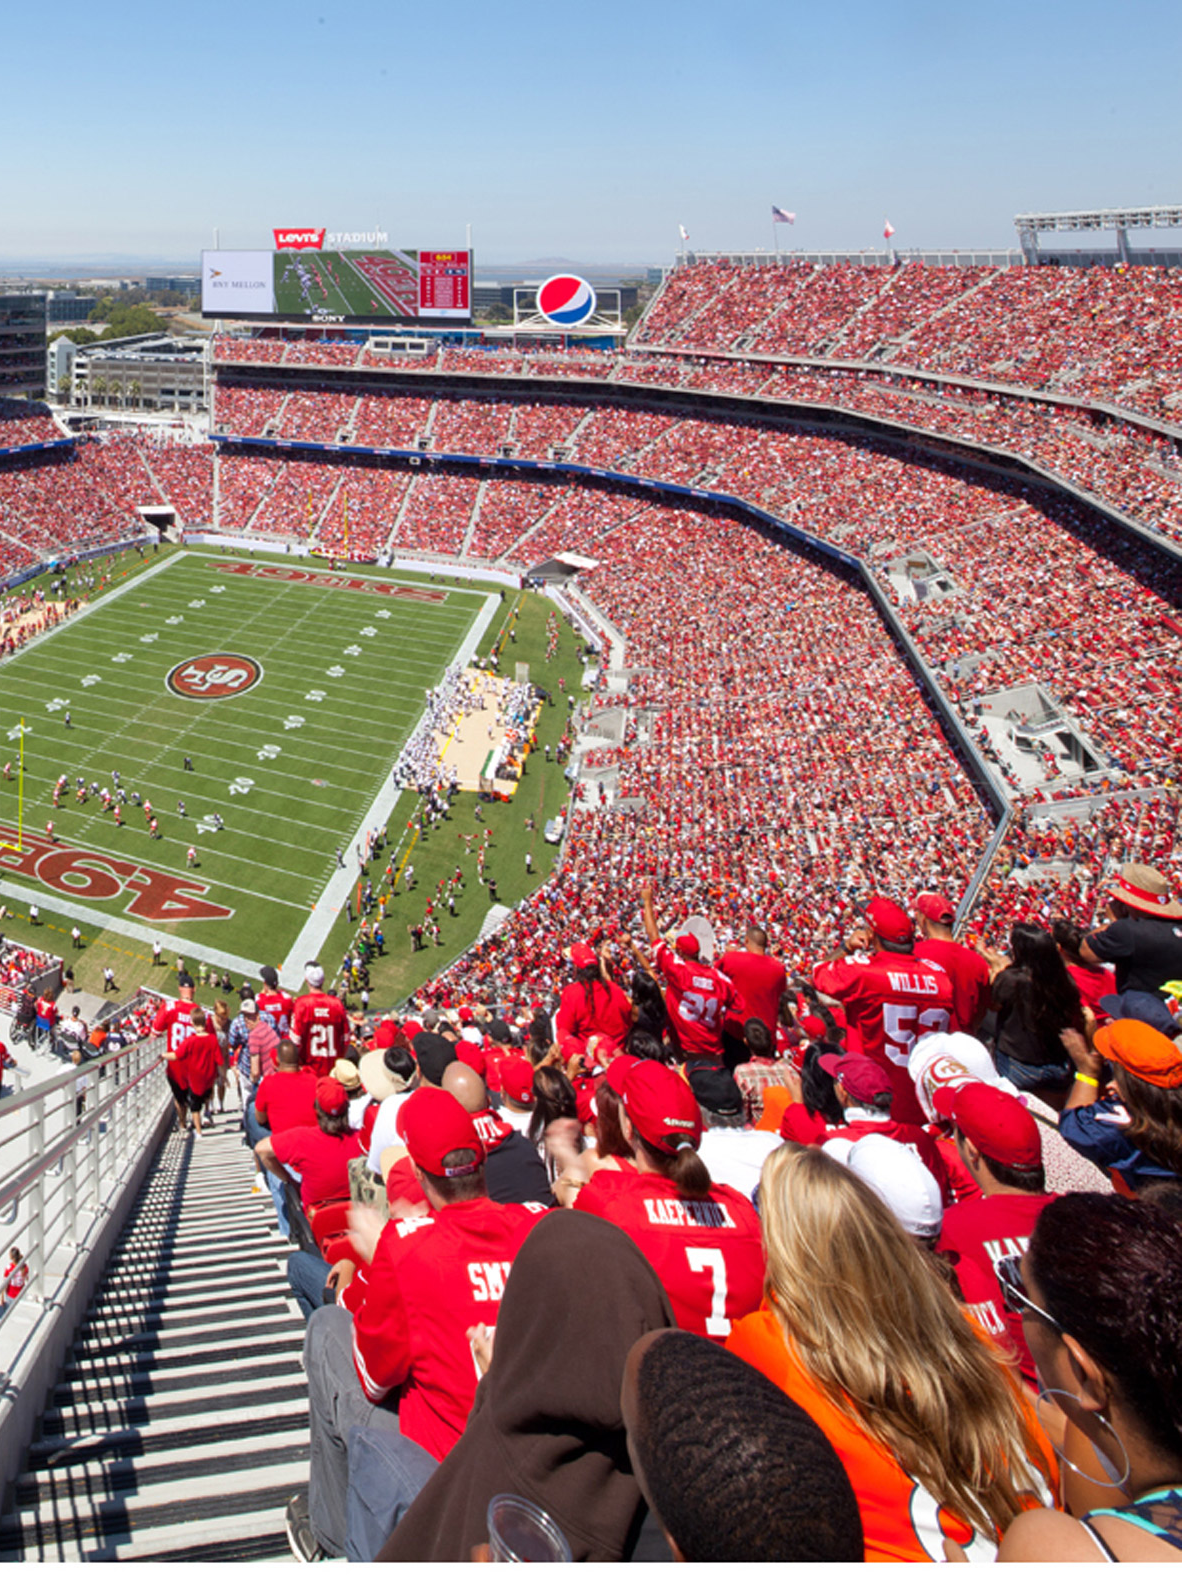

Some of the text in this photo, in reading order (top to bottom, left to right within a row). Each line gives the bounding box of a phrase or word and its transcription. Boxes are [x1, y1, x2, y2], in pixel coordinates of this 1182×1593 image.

[327, 232, 388, 243] STADIUM
[212, 280, 266, 289] BNY MELLON
[312, 315, 346, 323] SONY
[887, 971, 939, 996] WILLIS
[310, 1024, 337, 1057] 21
[643, 1198, 737, 1229] KAEPERNICK
[684, 1246, 732, 1337] 7
